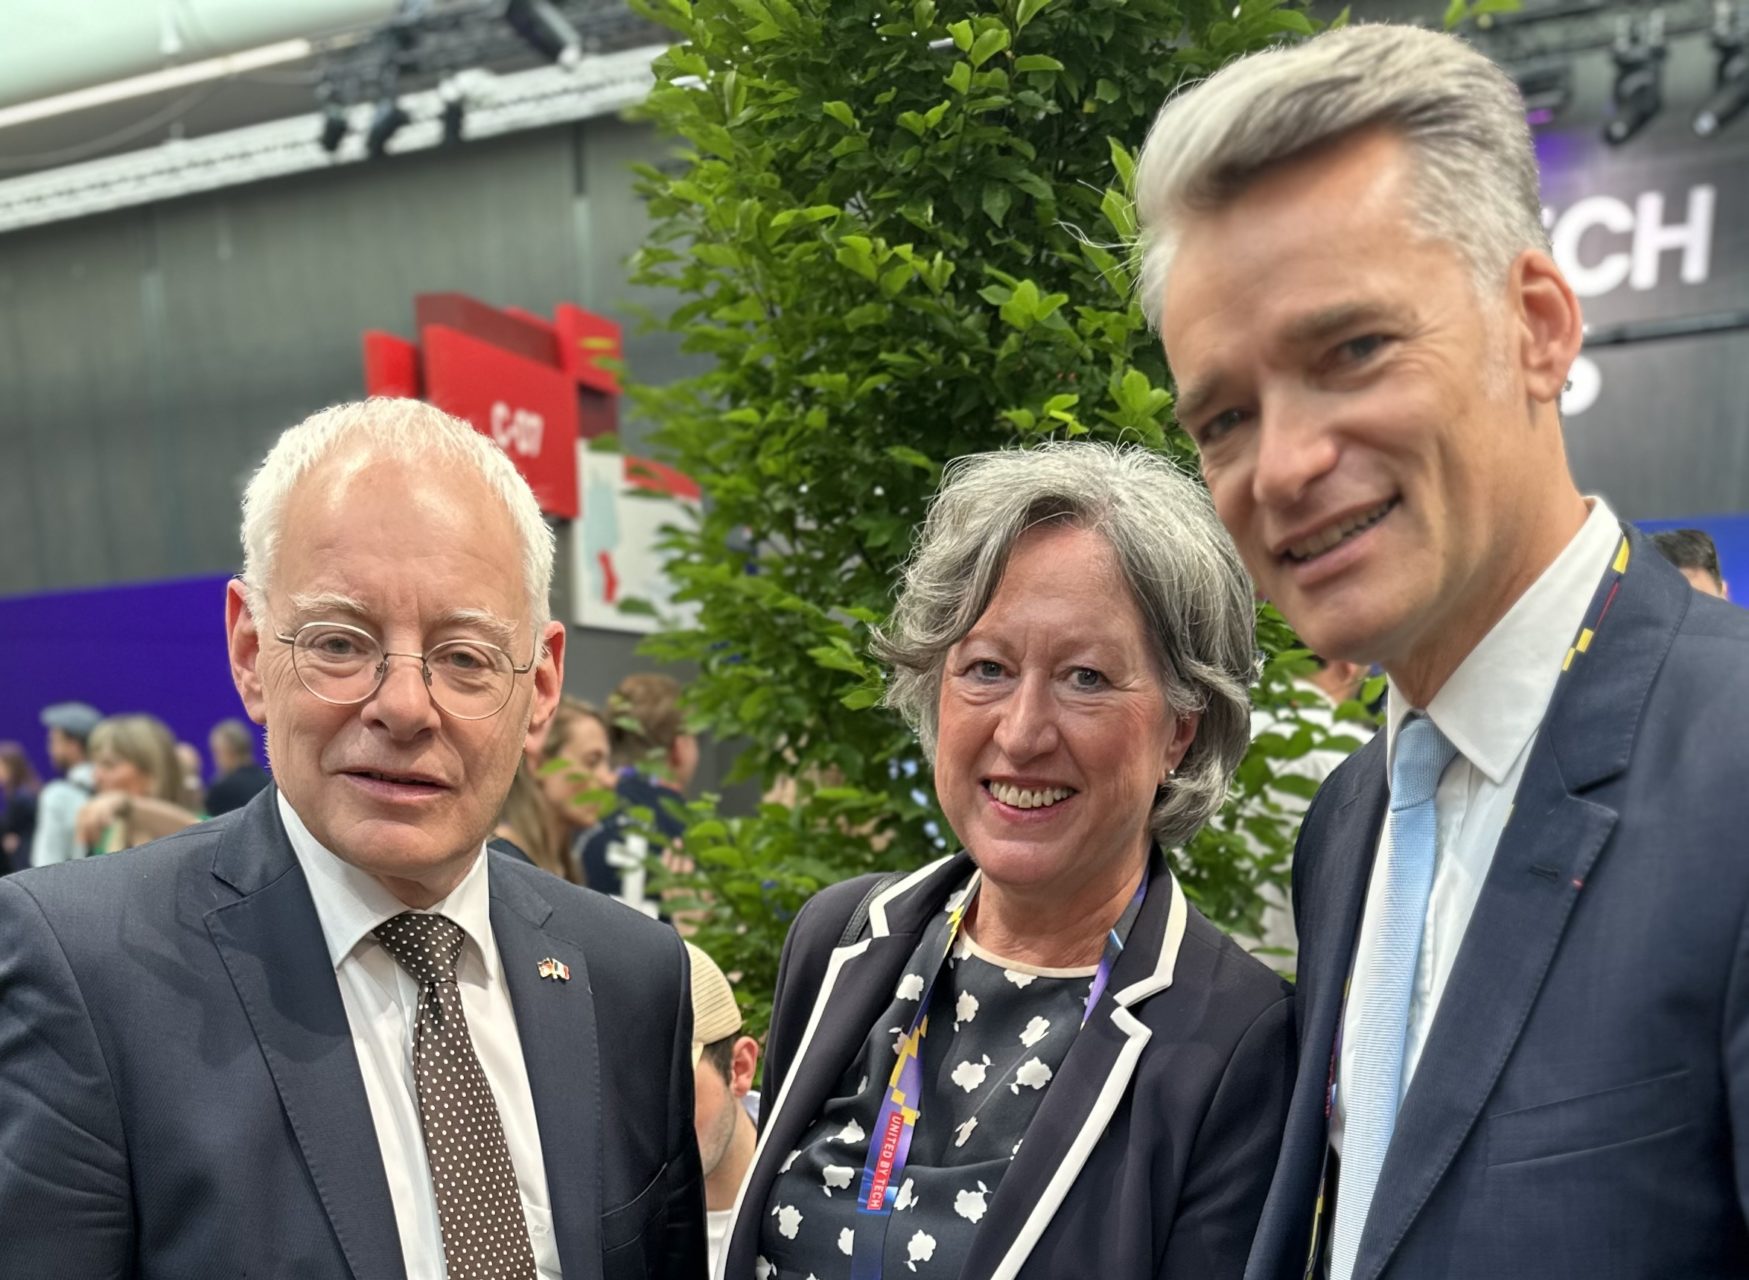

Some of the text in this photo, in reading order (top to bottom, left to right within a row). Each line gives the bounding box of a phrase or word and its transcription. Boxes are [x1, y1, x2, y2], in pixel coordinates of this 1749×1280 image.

[1541, 184, 1716, 298] CH
[869, 1115, 901, 1209] UNITED BY TECH
